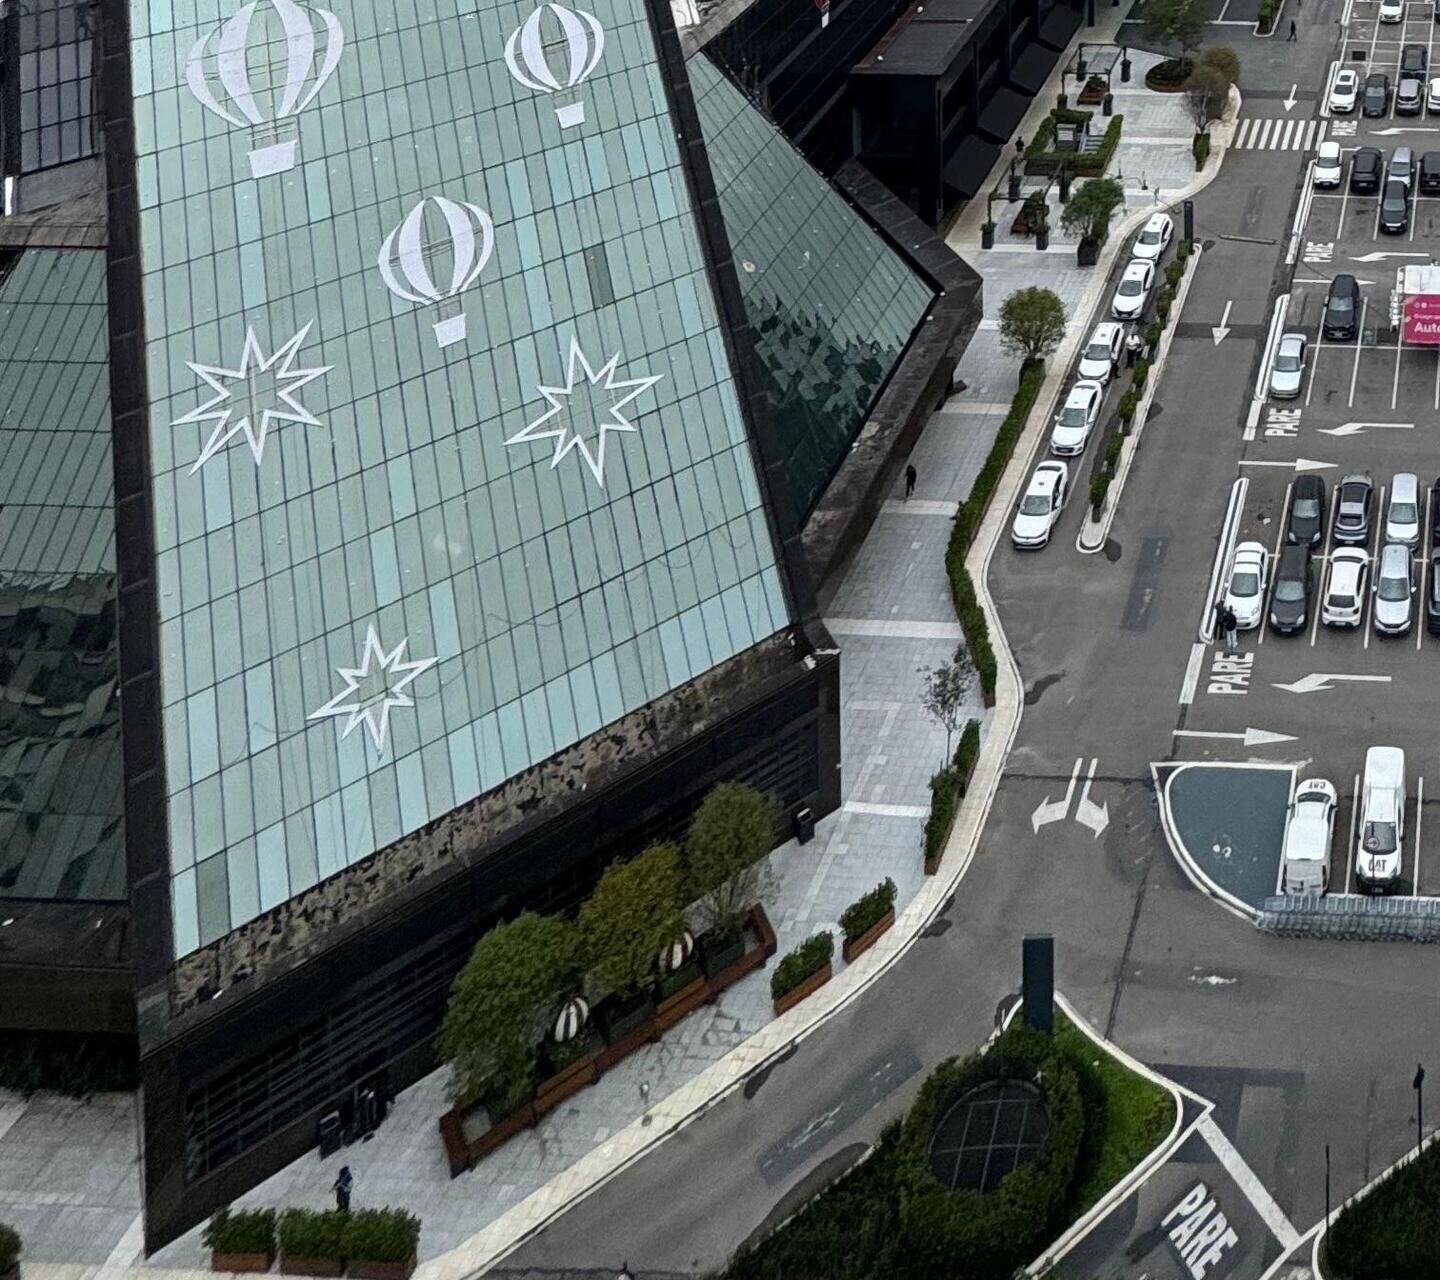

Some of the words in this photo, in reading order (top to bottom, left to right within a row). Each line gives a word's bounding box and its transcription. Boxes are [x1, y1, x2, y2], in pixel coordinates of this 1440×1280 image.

[1303, 241, 1334, 262] PARE
[1264, 408, 1301, 436] PARE
[1207, 651, 1254, 694] PARE
[1161, 1183, 1239, 1280] PARE
